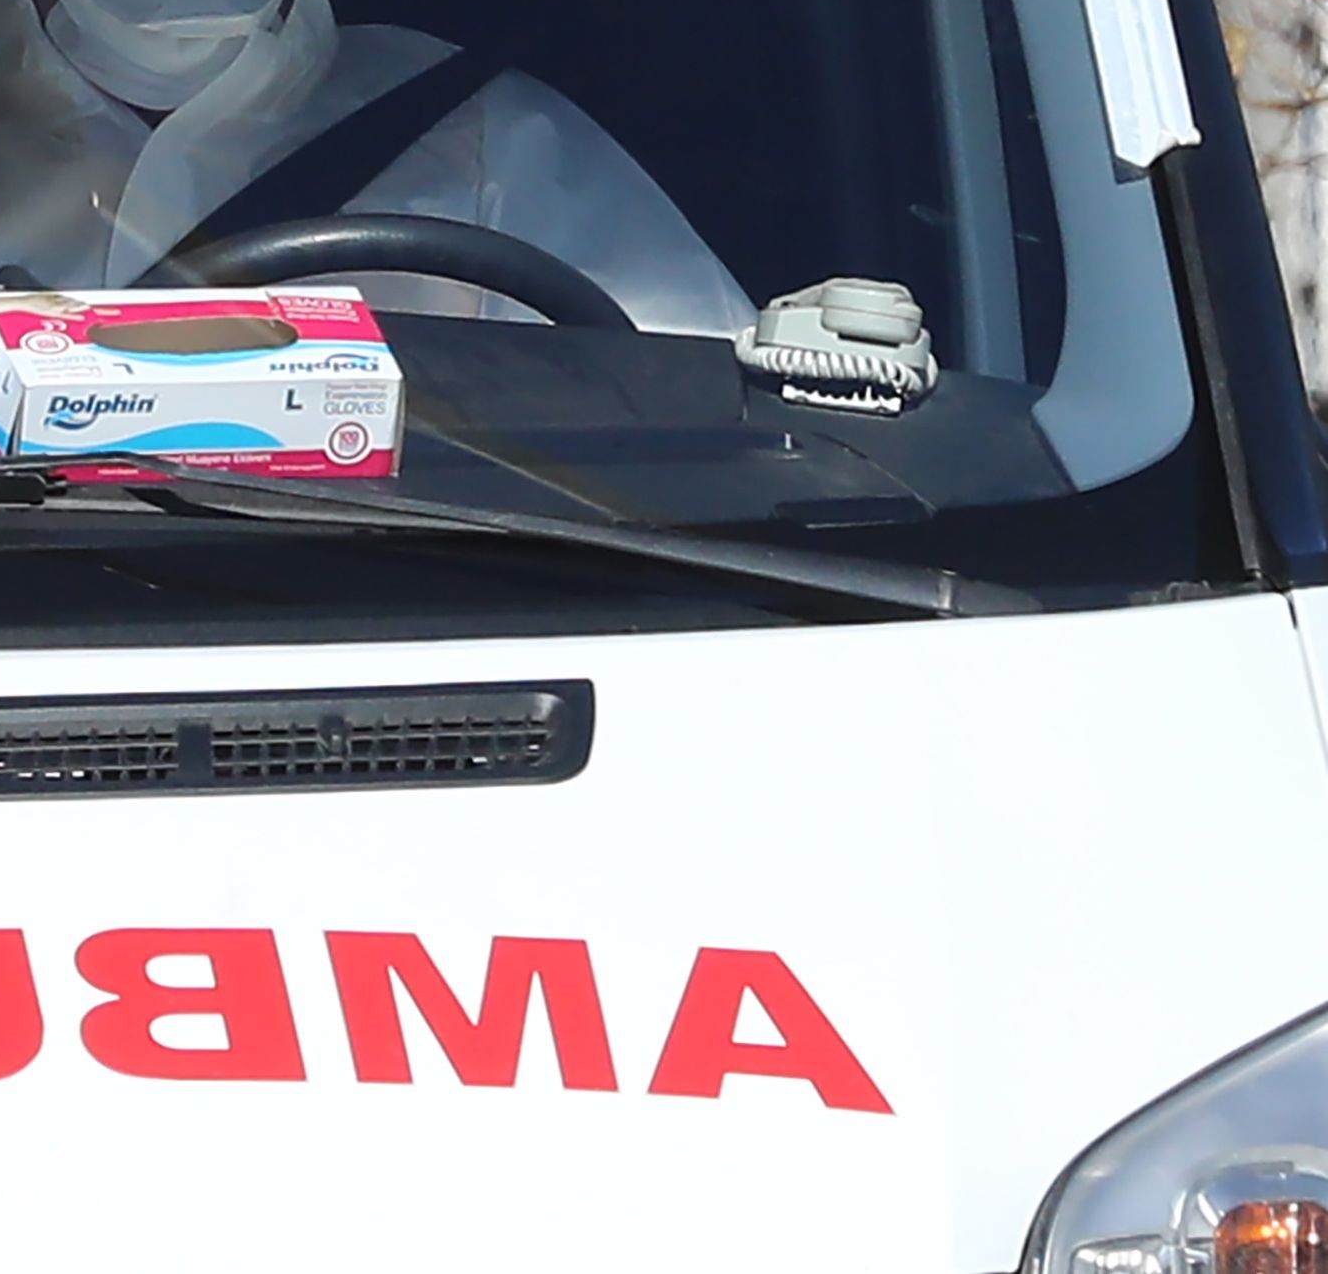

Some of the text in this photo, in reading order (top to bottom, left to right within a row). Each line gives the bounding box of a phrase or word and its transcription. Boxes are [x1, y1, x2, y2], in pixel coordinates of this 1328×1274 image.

[269, 352, 379, 374] Dolphin
[43, 393, 157, 430] Dolphin
[284, 389, 304, 412] L
[323, 400, 387, 416] GLOVES
